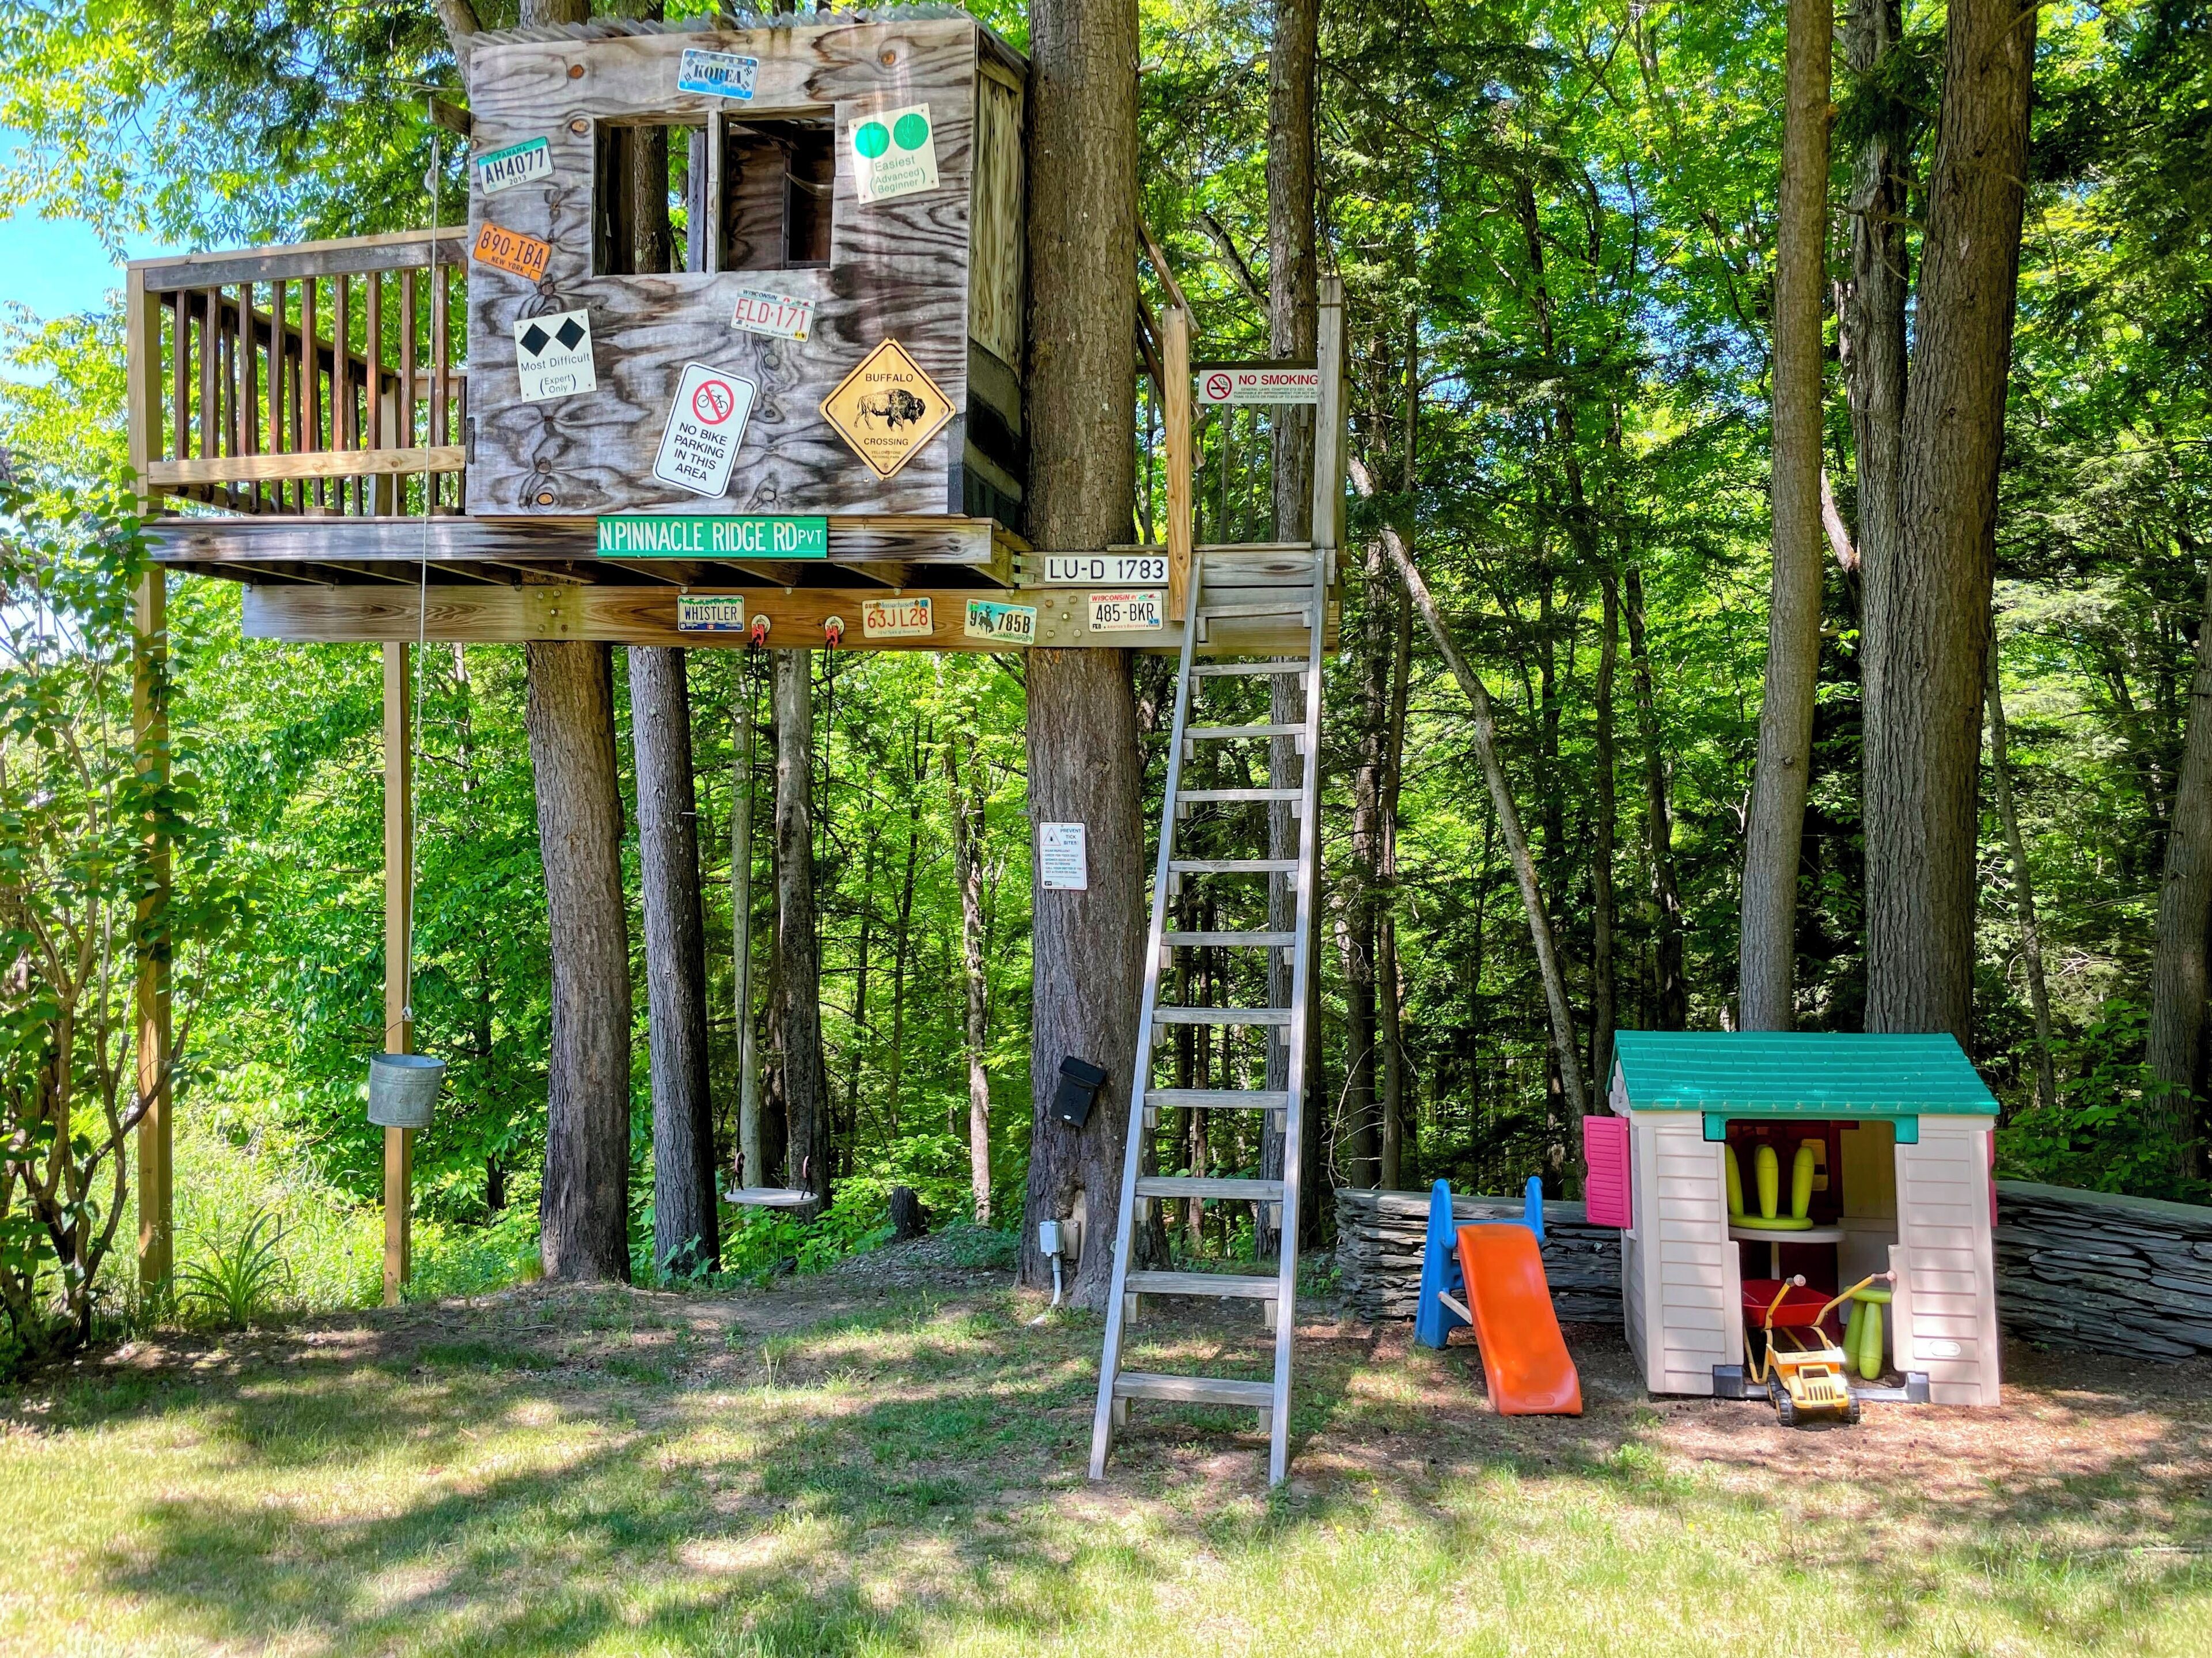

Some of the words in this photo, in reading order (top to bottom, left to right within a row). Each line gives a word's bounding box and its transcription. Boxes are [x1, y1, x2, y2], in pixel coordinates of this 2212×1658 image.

[694, 64, 741, 84] KOREA
[497, 146, 527, 159] PANAMA
[486, 147, 543, 184] AH4077
[875, 154, 915, 172] Easiest
[509, 175, 527, 185] 2013
[491, 256, 506, 266] NEW
[508, 262, 525, 272] YORK
[743, 289, 778, 301] WISCONSIN
[521, 360, 546, 372] Most
[550, 353, 590, 368] Difficult
[865, 373, 914, 383] BUFFALO
[1238, 375, 1257, 385] NO
[1261, 374, 1318, 385] SMOKING
[679, 422, 697, 436] NO
[700, 429, 728, 446] BIKE
[863, 438, 909, 446] CROSSING
[674, 434, 725, 459] PARKING
[674, 448, 687, 460] IN
[691, 453, 717, 470] THIS
[675, 463, 707, 481] AREA
[712, 521, 766, 551] RIDGE
[773, 522, 797, 551] RD
[797, 529, 823, 545] PVT
[1050, 559, 1105, 580] LU-D
[1116, 559, 1164, 579] 1783
[684, 606, 737, 621] WHISTLER
[1096, 603, 1154, 623] 485-BKR
[969, 611, 978, 626] 9
[998, 612, 1031, 634] 785B
